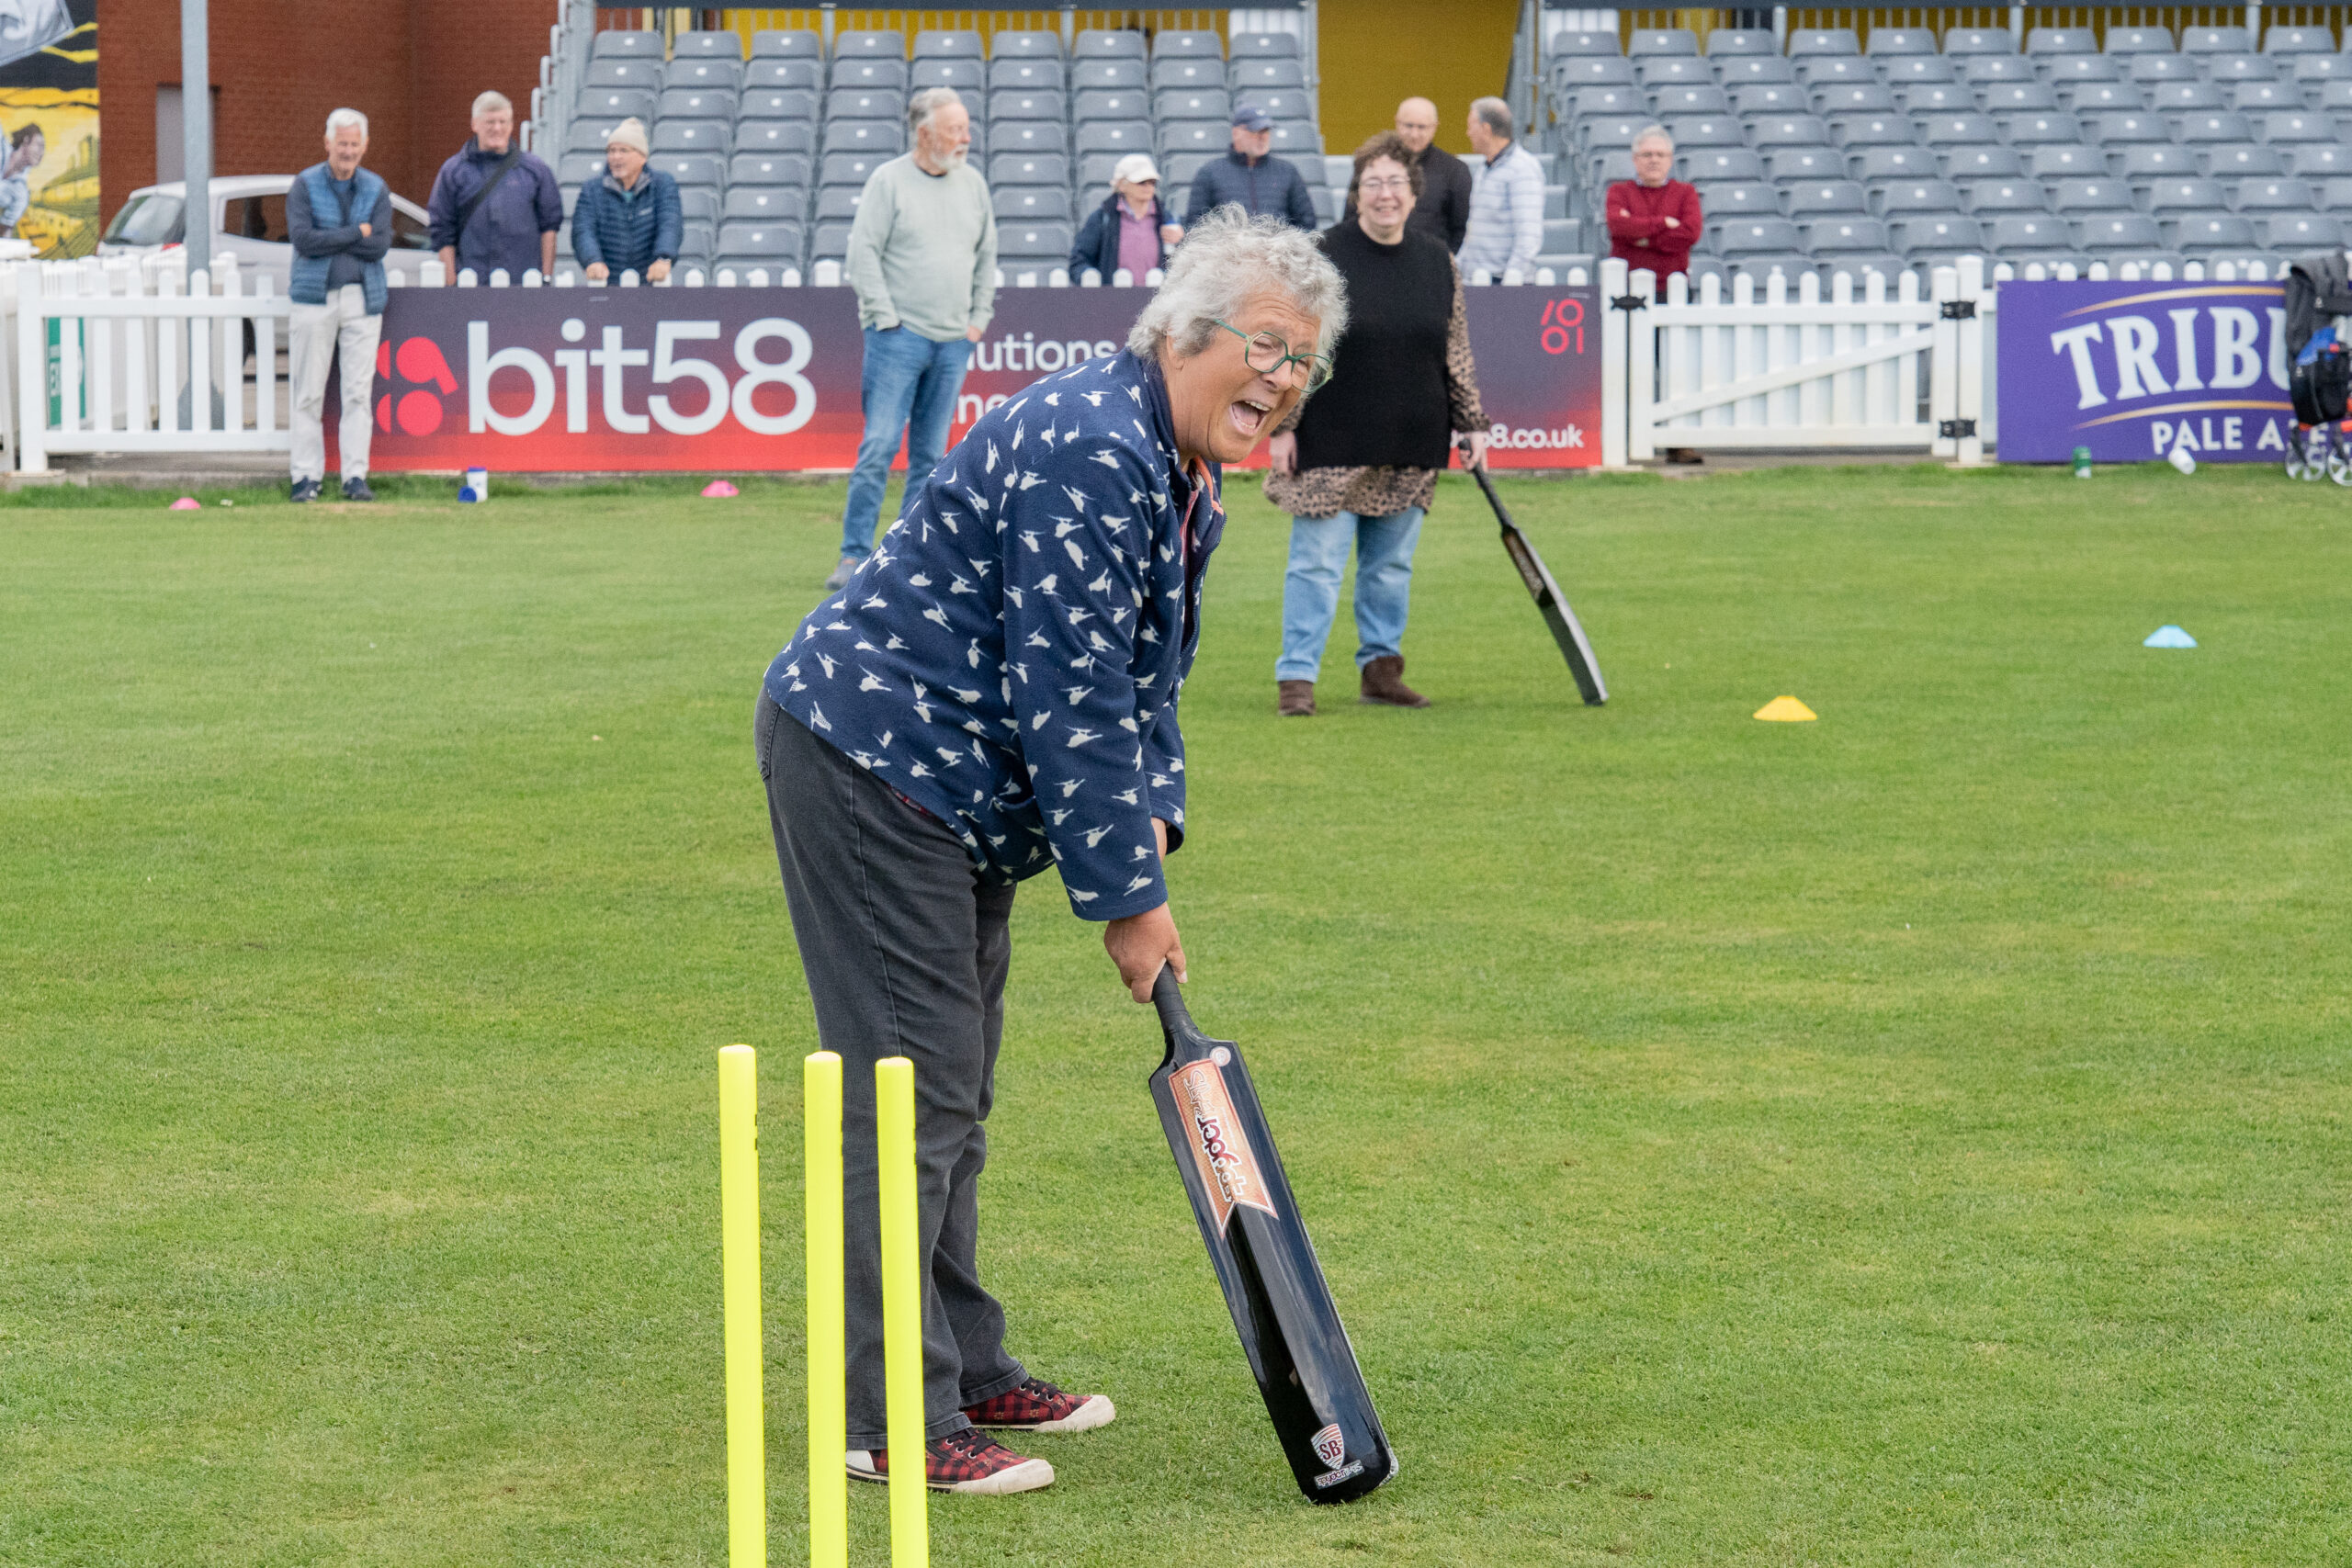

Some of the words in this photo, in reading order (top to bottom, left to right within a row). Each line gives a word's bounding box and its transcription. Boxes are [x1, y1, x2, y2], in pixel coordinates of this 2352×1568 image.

[967, 332, 1118, 371] utions
[467, 317, 817, 435] bit58
[1450, 423, 1584, 448] 8.co.uk
[2151, 416, 2244, 455] PALE
[1319, 1440, 1341, 1460] SB
